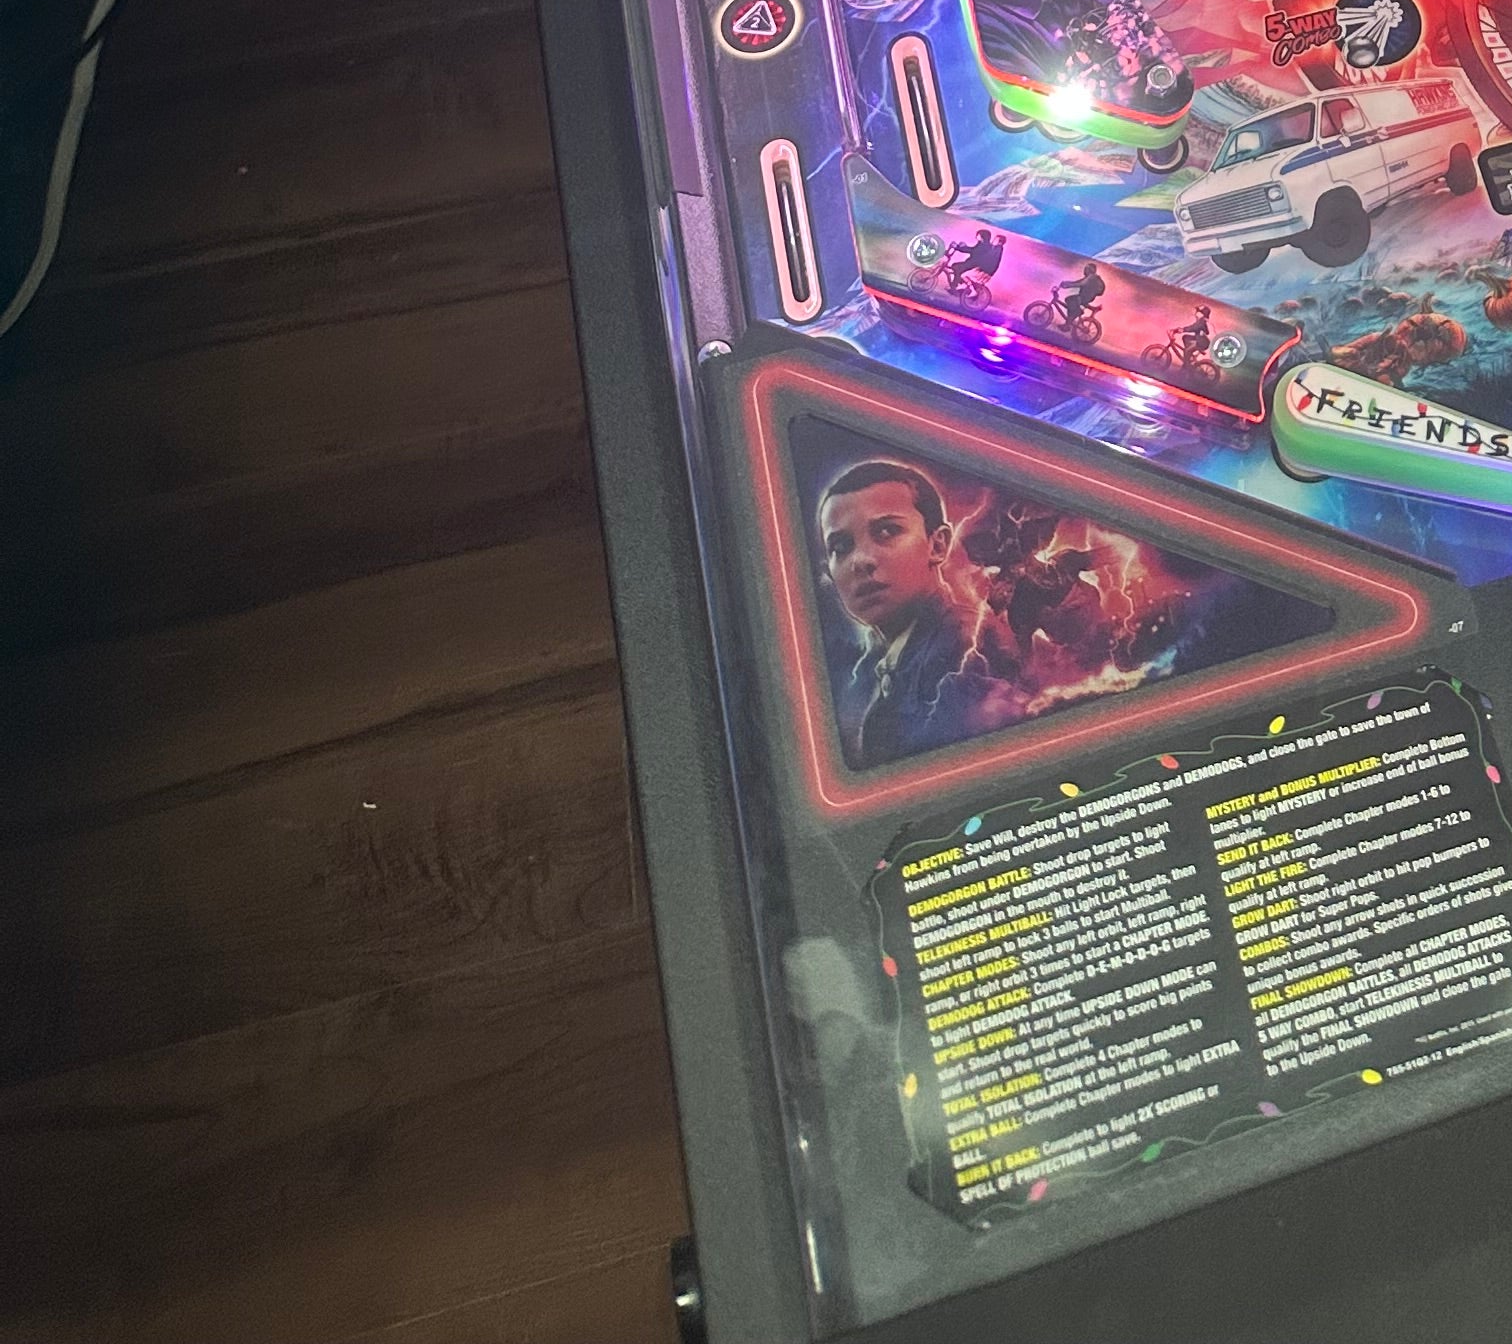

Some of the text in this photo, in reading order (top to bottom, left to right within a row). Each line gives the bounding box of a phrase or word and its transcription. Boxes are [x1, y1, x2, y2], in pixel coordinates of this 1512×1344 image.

[1316, 388, 1511, 458] FRIENDS
[1205, 732, 1466, 819] MYSTERY and BONUS MULTIPLIER: Complete Bottom
[902, 815, 1058, 879] OBJECTIVE: Save Will, destroy
[1217, 847, 1247, 866] SEND
[1261, 832, 1294, 852] BACK:
[908, 855, 1064, 918] DEMOGORGON BATTLE: Shoot
[1251, 965, 1354, 1011] FINAL SHOWDOWN:
